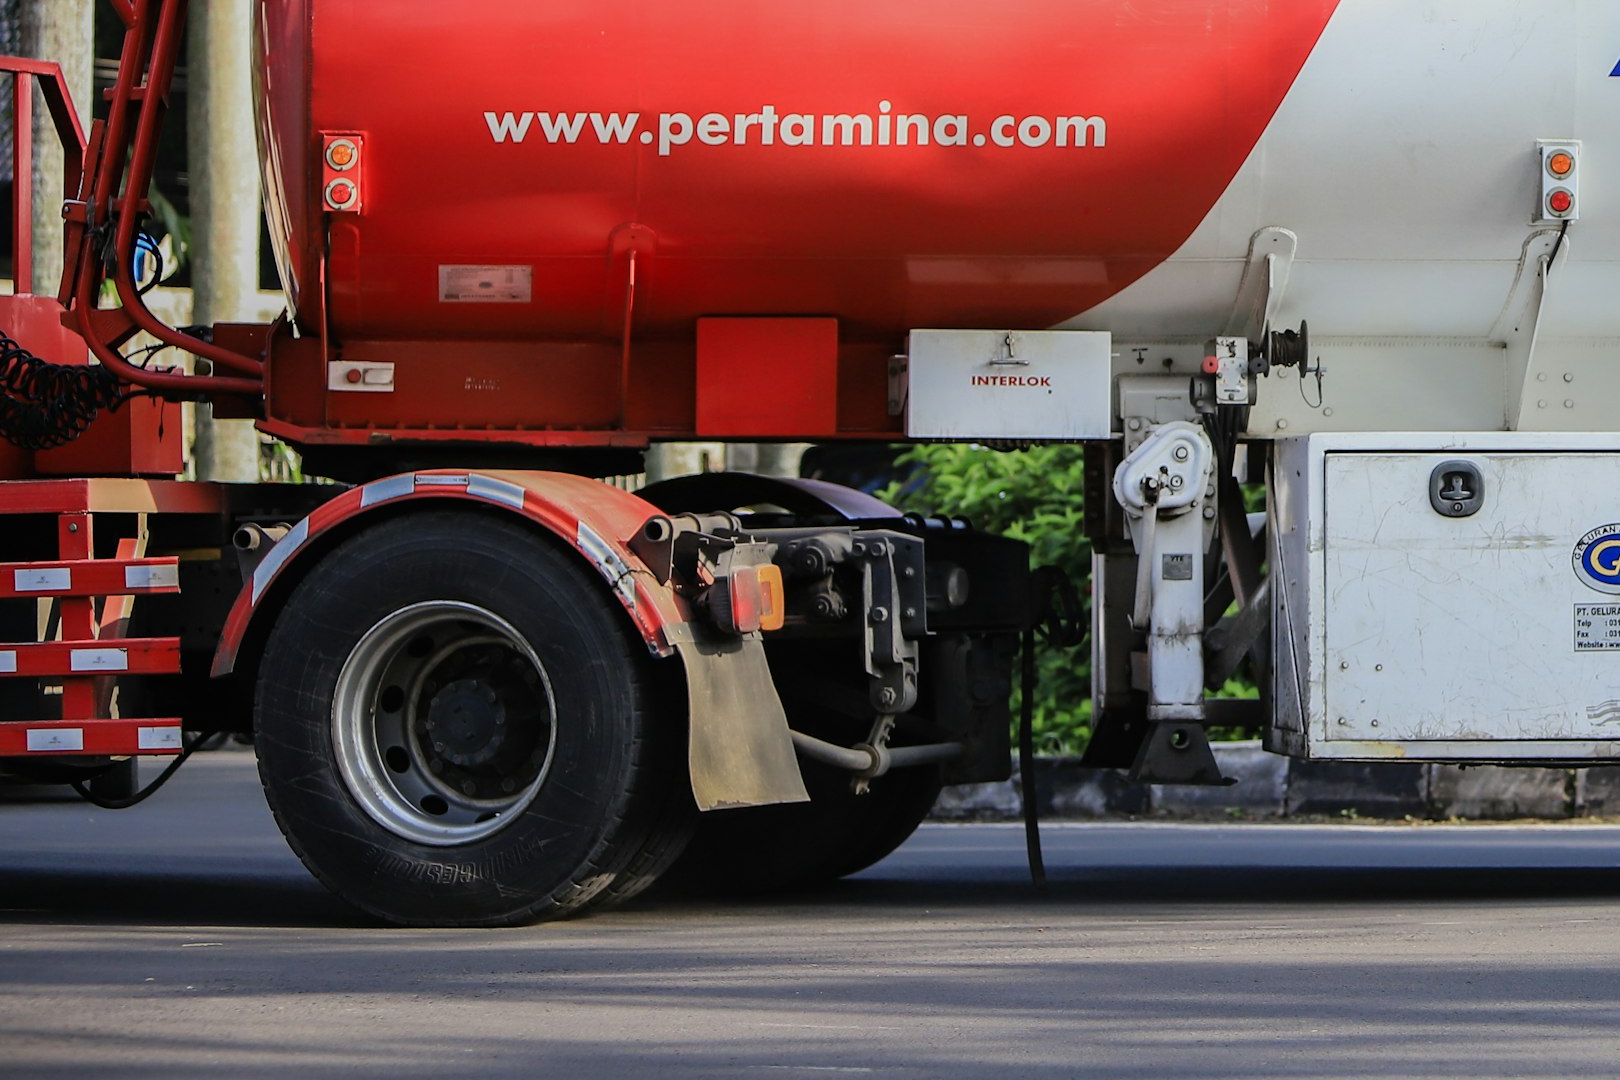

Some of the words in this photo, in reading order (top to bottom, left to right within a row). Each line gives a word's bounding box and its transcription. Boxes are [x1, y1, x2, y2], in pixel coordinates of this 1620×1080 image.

[483, 99, 1108, 157] www.pertamina.com
[971, 375, 1052, 387] INTERLOK
[1574, 525, 1617, 560] GELURAN
[1577, 619, 1592, 628] Telp
[1577, 630, 1589, 638] Fax
[1577, 640, 1604, 648] Website
